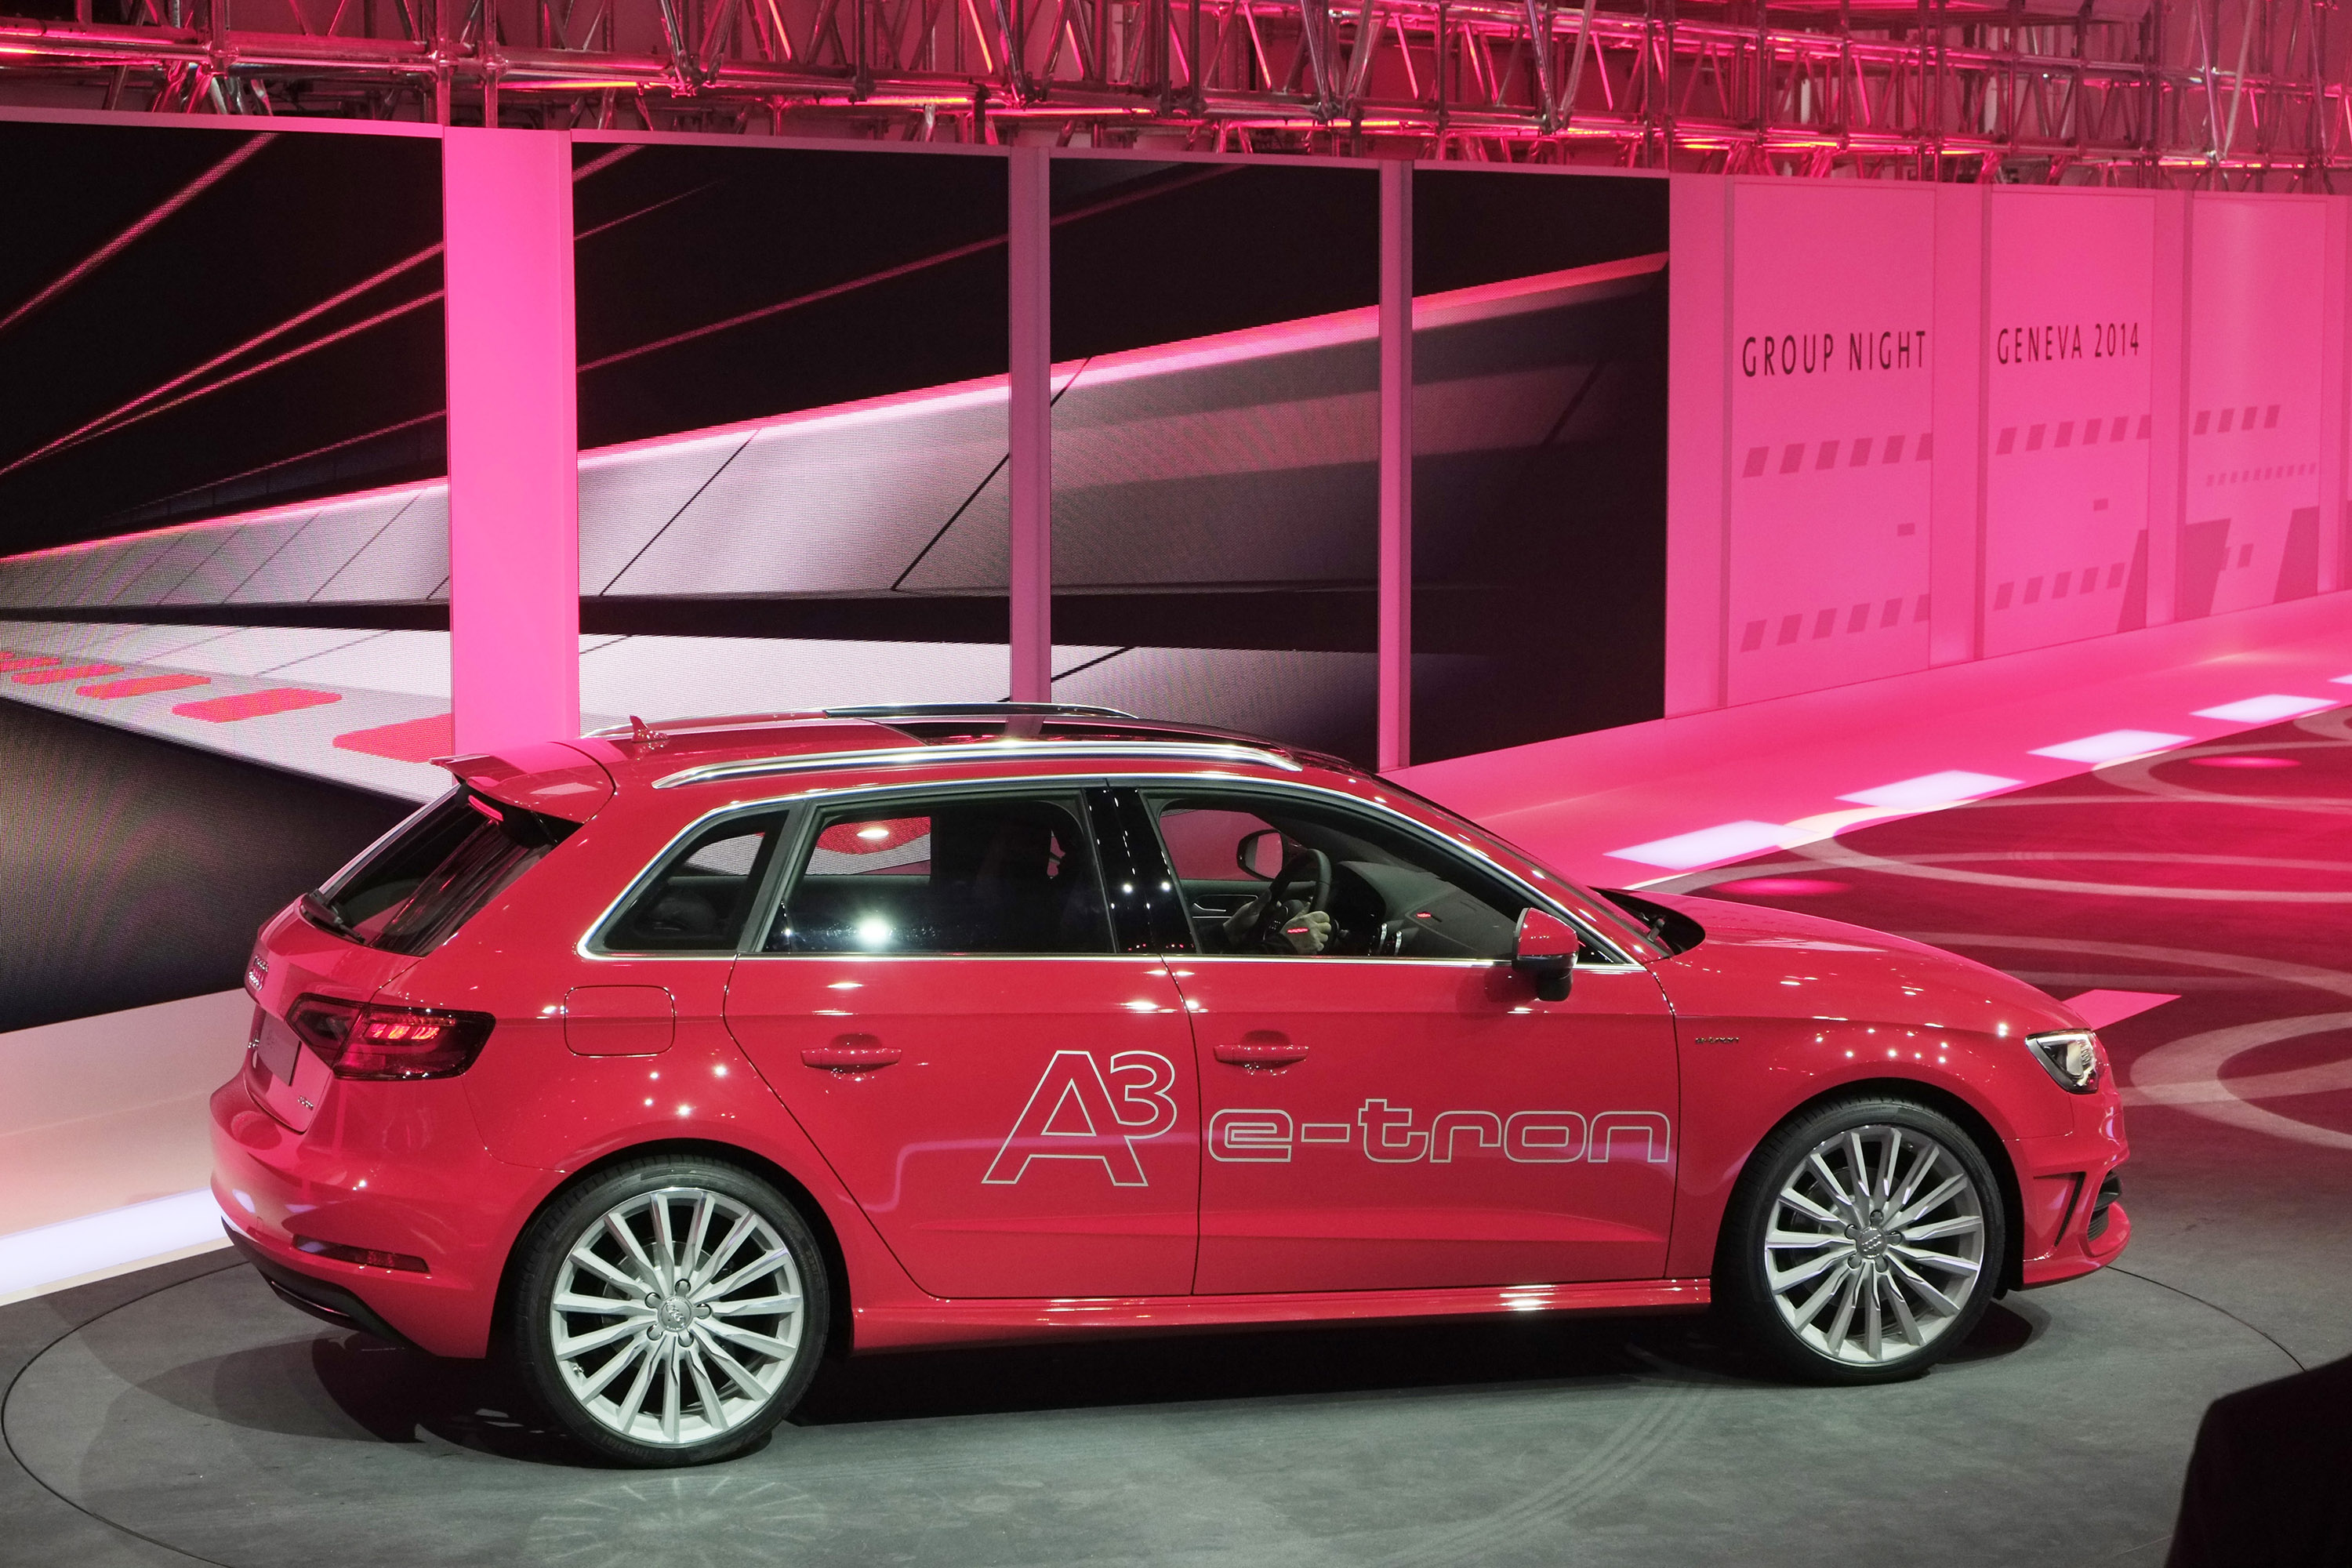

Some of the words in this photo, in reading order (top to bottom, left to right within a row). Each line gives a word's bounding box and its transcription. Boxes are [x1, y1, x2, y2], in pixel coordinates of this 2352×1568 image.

[1742, 332, 1834, 377] GROUP
[1849, 330, 1926, 372] NIGHT
[1997, 324, 2082, 365] GENEVA
[2094, 322, 2140, 358] 2014
[982, 1050, 1178, 1187] A3
[1208, 1098, 1671, 1163] e-tron
